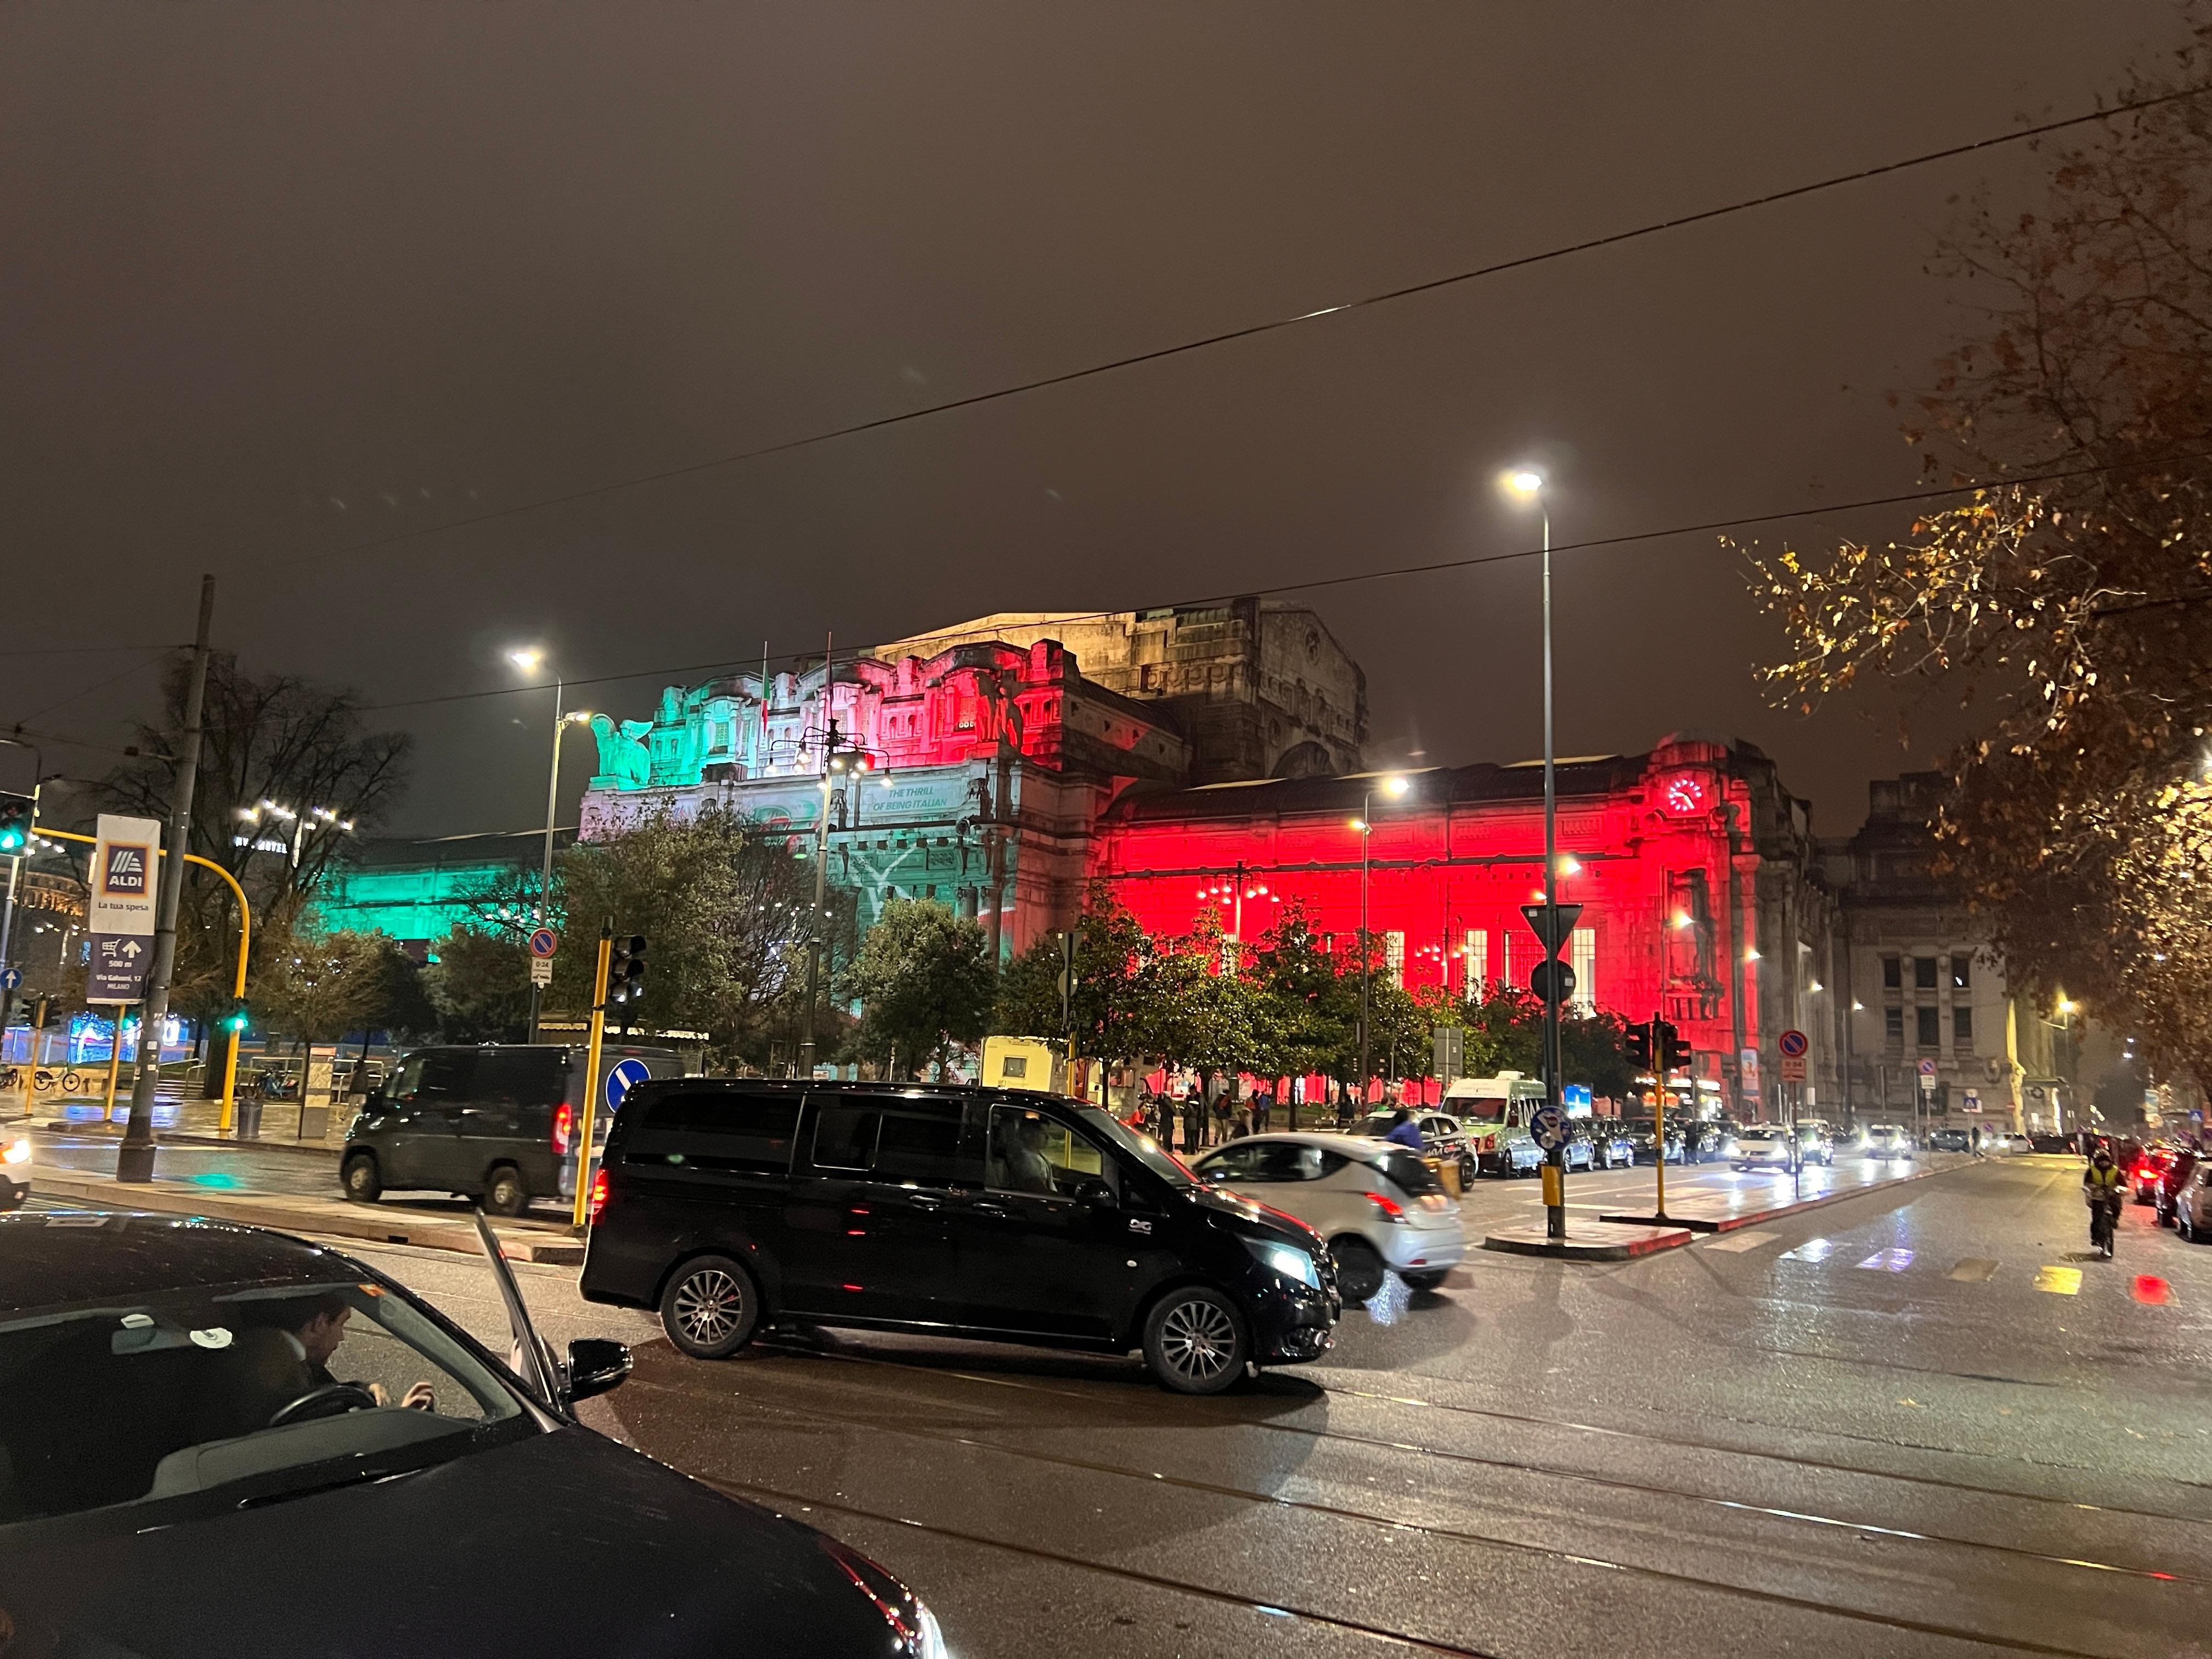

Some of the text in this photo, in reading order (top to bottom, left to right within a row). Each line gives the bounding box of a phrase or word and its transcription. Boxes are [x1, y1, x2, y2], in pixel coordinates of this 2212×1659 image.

[889, 787, 933, 798] THE THRILL
[873, 798, 947, 811] OF BEING ITALIAN
[109, 876, 142, 887] ALDI
